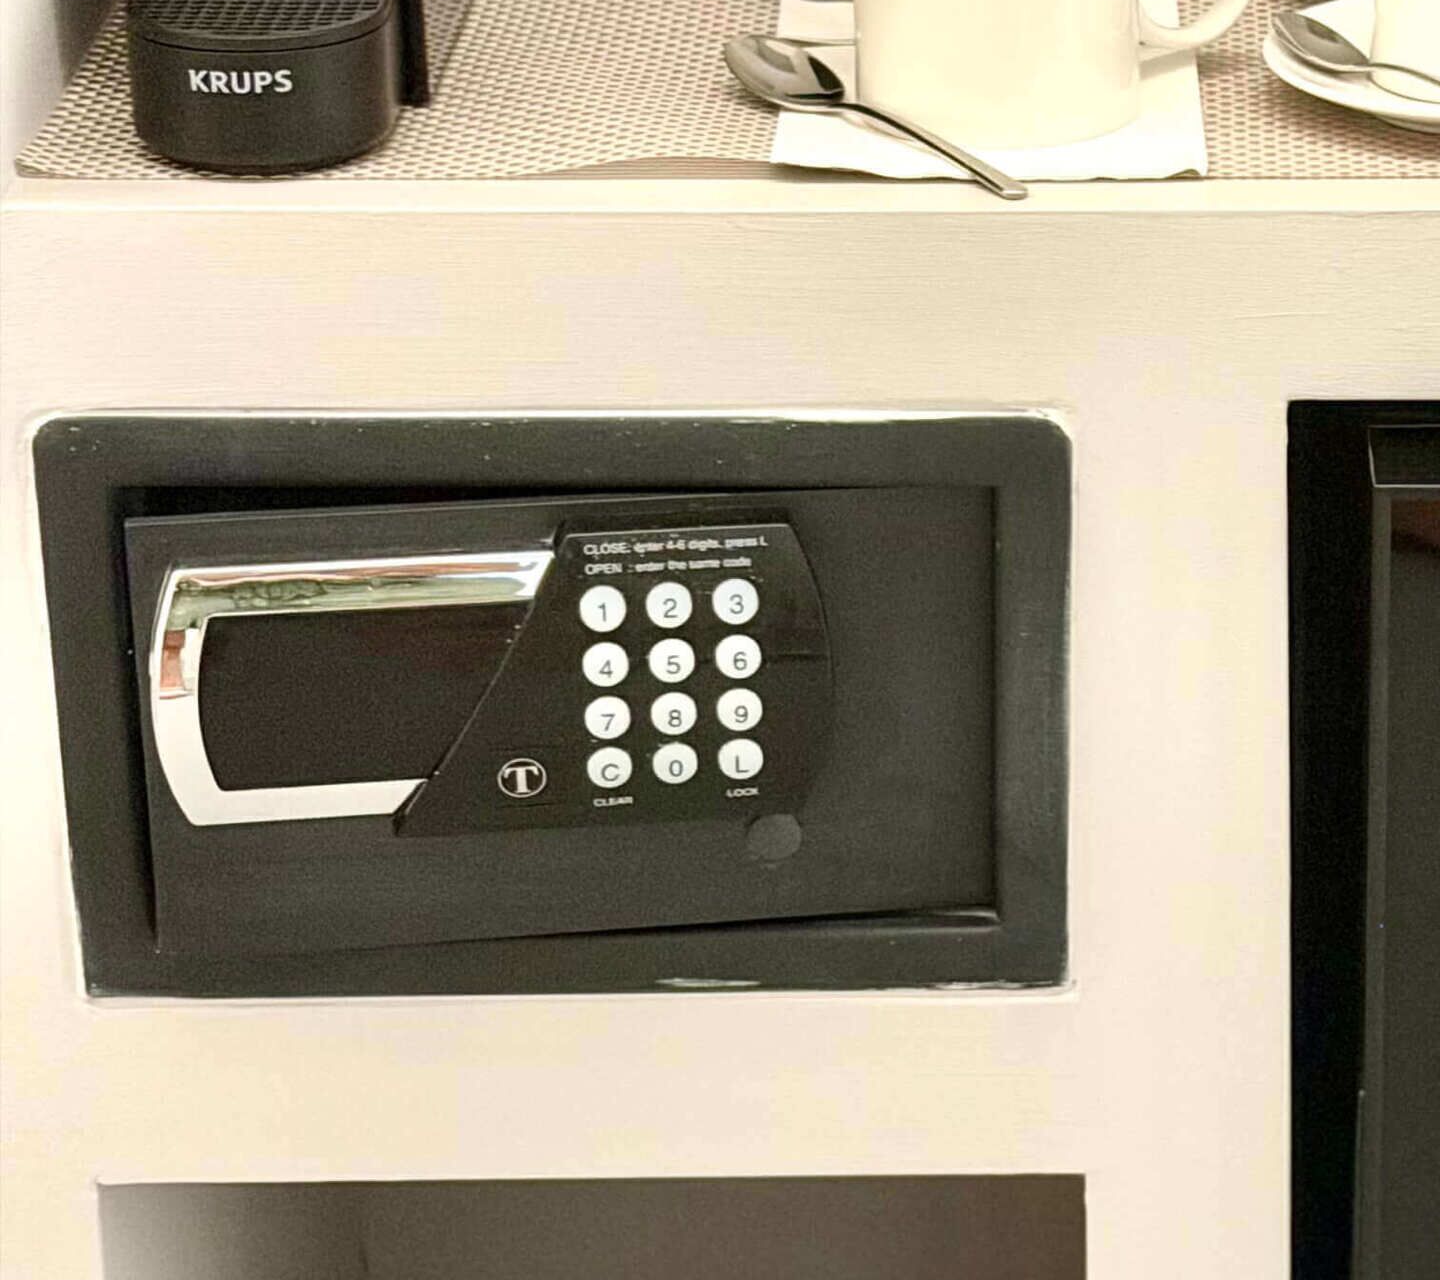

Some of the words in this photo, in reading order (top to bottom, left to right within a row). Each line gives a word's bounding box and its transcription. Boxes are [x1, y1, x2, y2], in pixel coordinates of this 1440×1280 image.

[188, 69, 293, 94] KRUPS
[759, 536, 769, 546] L
[584, 563, 623, 575] OPEN
[598, 603, 608, 621] 1
[663, 598, 678, 618] 2
[729, 594, 745, 614] 3
[599, 660, 613, 678] 4
[666, 655, 681, 674] 5
[733, 651, 748, 670] 6
[600, 713, 616, 731] 7
[668, 709, 683, 727] 8
[734, 704, 749, 723] 9
[601, 763, 620, 782] C
[734, 755, 749, 773] L
[593, 796, 634, 807] CLEAR
[725, 787, 759, 798] LOCK
